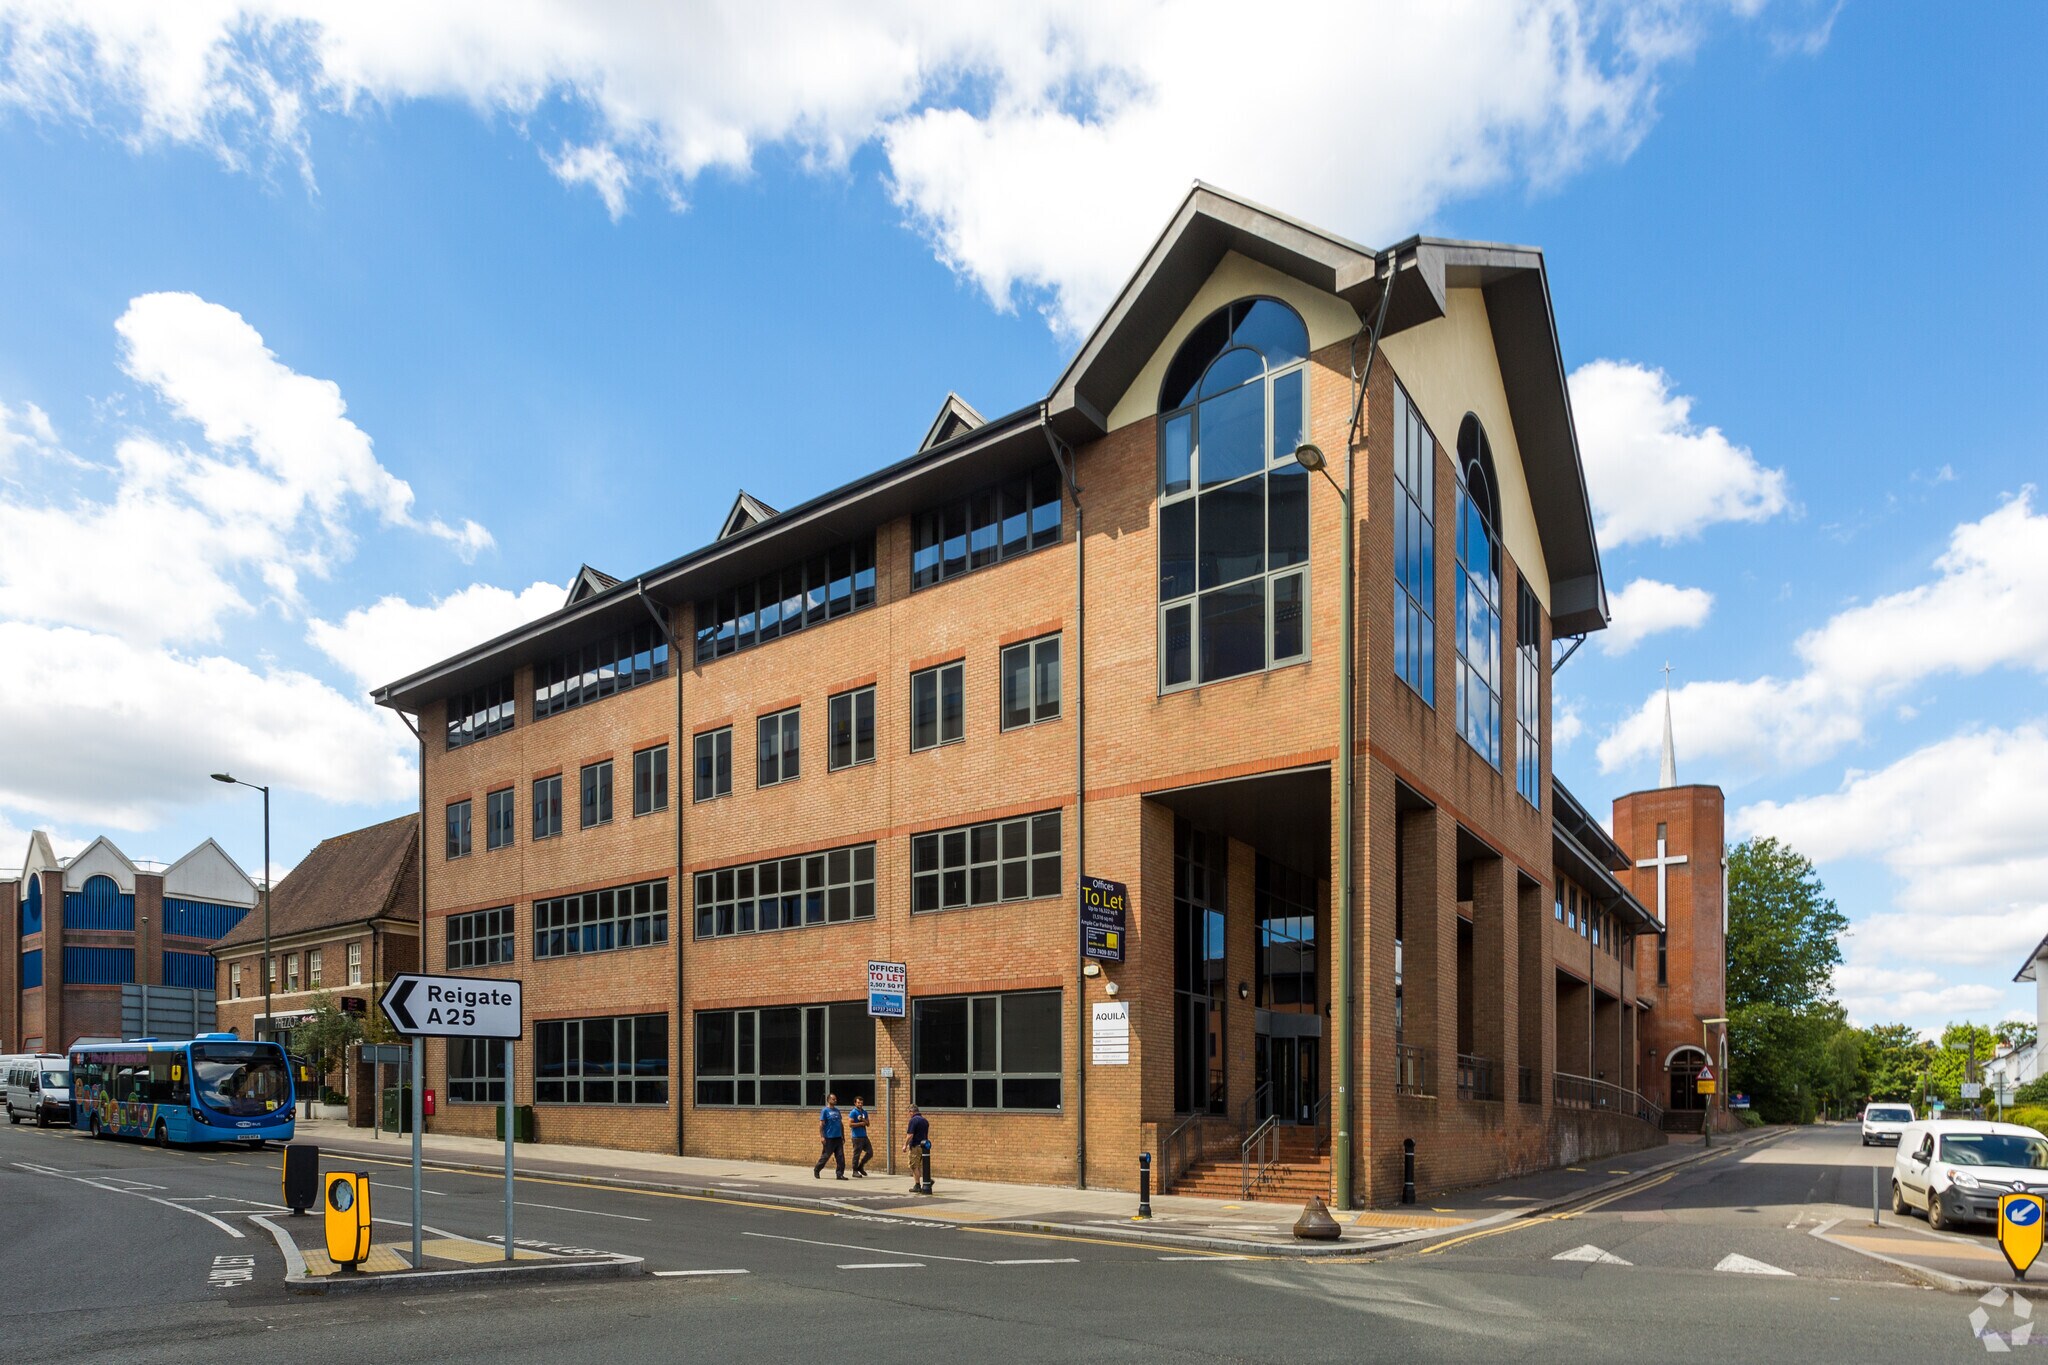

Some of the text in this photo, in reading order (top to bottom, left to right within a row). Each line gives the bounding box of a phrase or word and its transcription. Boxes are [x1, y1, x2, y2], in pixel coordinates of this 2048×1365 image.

[1093, 879, 1114, 891] Offices
[1082, 887, 1123, 910] To Let
[870, 964, 904, 973] OFFICES
[870, 972, 904, 982] TO LET
[427, 985, 512, 1007] Reigate
[427, 1008, 475, 1025] A25
[1096, 1012, 1126, 1020] AQUILA
